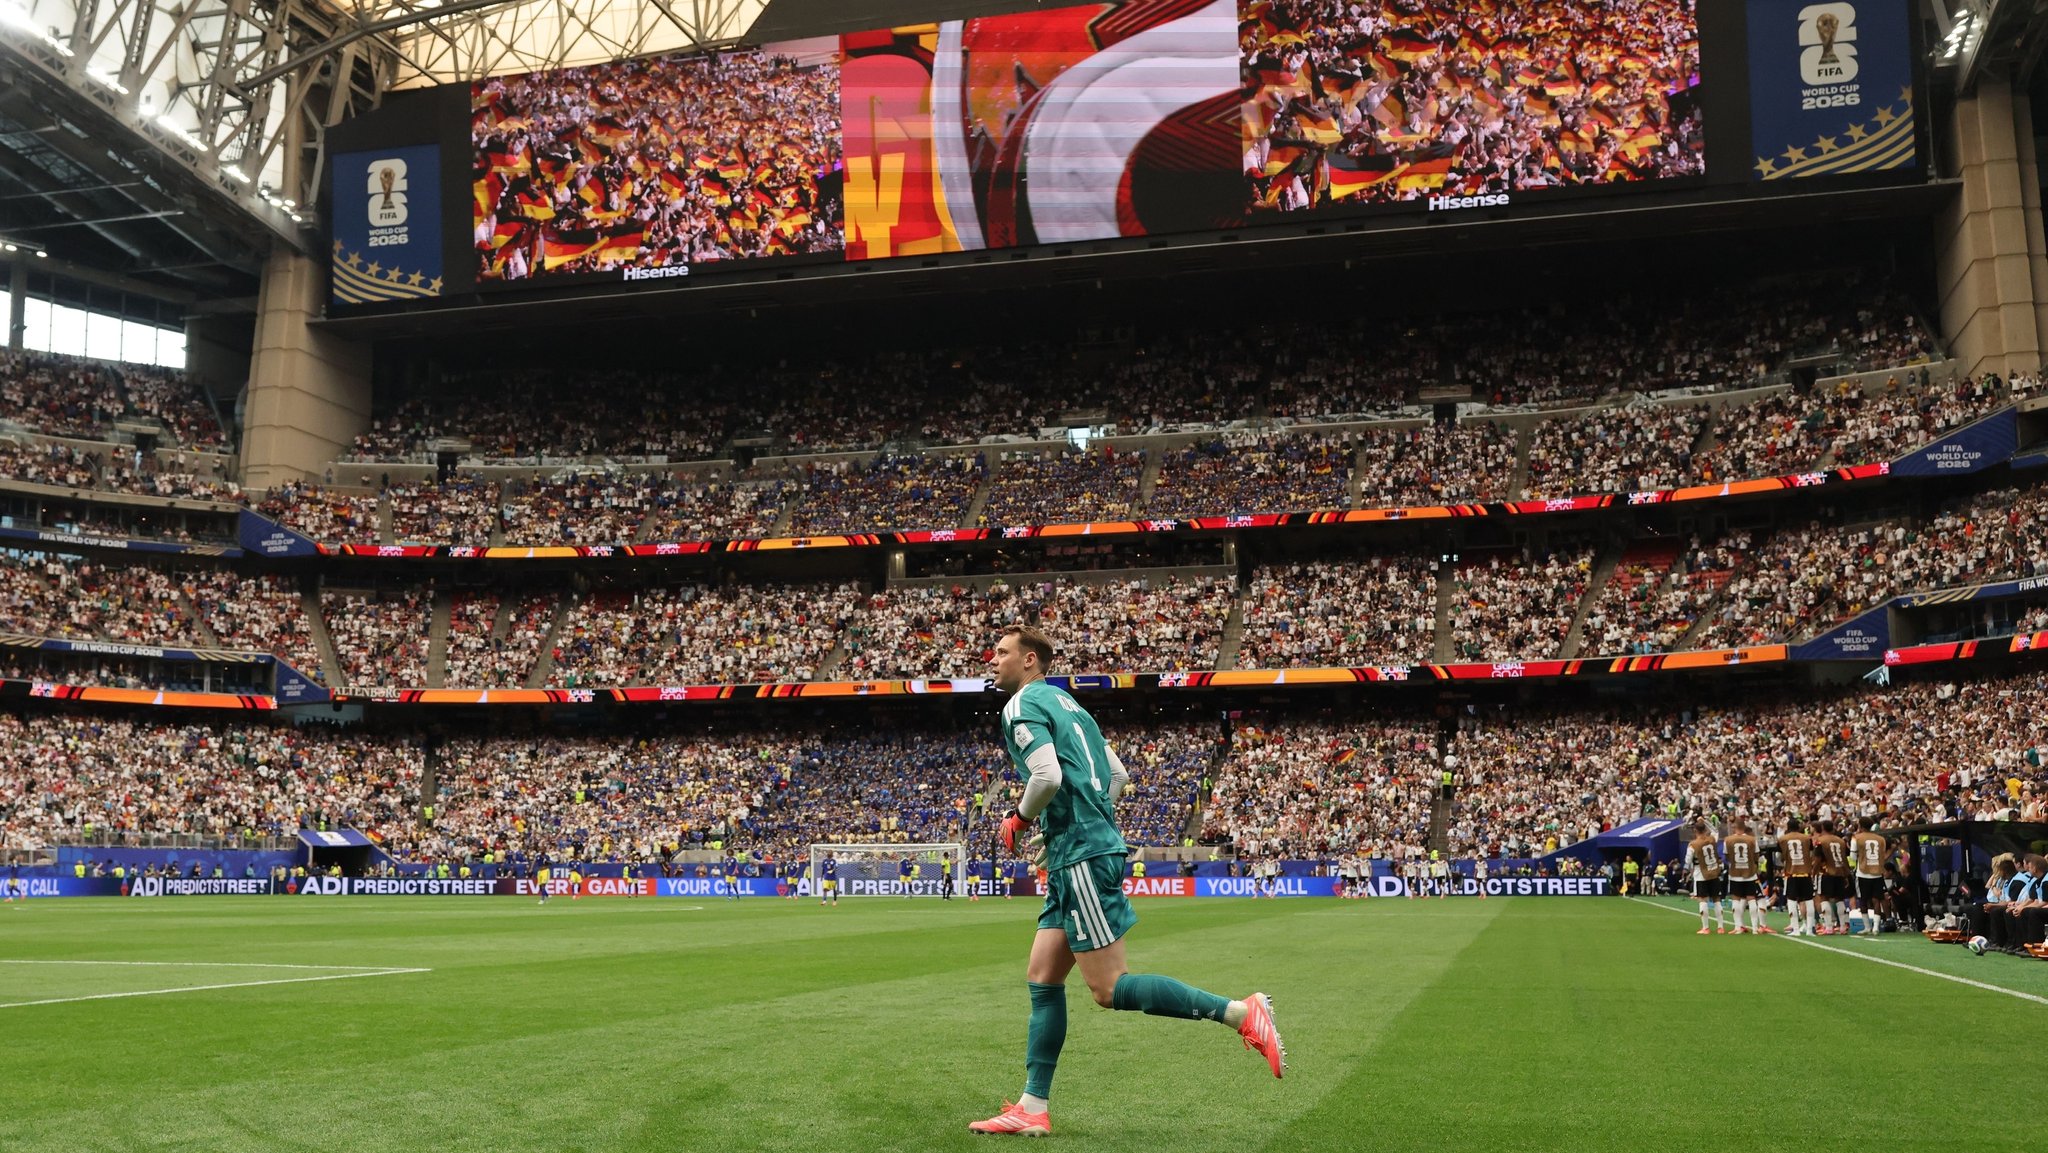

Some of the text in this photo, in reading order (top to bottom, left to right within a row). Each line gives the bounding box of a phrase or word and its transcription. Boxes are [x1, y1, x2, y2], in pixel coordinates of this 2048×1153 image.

[1818, 67, 1843, 77] FIFA
[1802, 84, 1859, 97] WORLD CUP
[1802, 93, 1860, 110] 2026
[1429, 193, 1509, 211] Hisense
[380, 212, 397, 220] FIFA
[368, 226, 408, 236] WORLD CUP
[368, 234, 408, 247] 2026
[623, 265, 689, 280] Hisense
[1927, 452, 1981, 461] WORLD CUP
[1937, 460, 1971, 469] 2026
[39, 532, 57, 541] FIFA
[56, 535, 84, 544] WORLD
[100, 540, 128, 548] 2026
[2019, 580, 2036, 592] FIFA
[71, 643, 163, 657] FIFA WORLD CUP 2026
[1072, 722, 1102, 792] 1
[553, 867, 571, 879] FIF
[31, 879, 60, 896] CALL
[131, 877, 268, 896] ADI PREDICTSTREET
[301, 877, 497, 895] ADI PREDICTSTREET
[667, 879, 710, 895] YOUR
[1121, 879, 1185, 895] GAME
[1207, 879, 1255, 895] YOUR
[1070, 909, 1087, 942] 1
